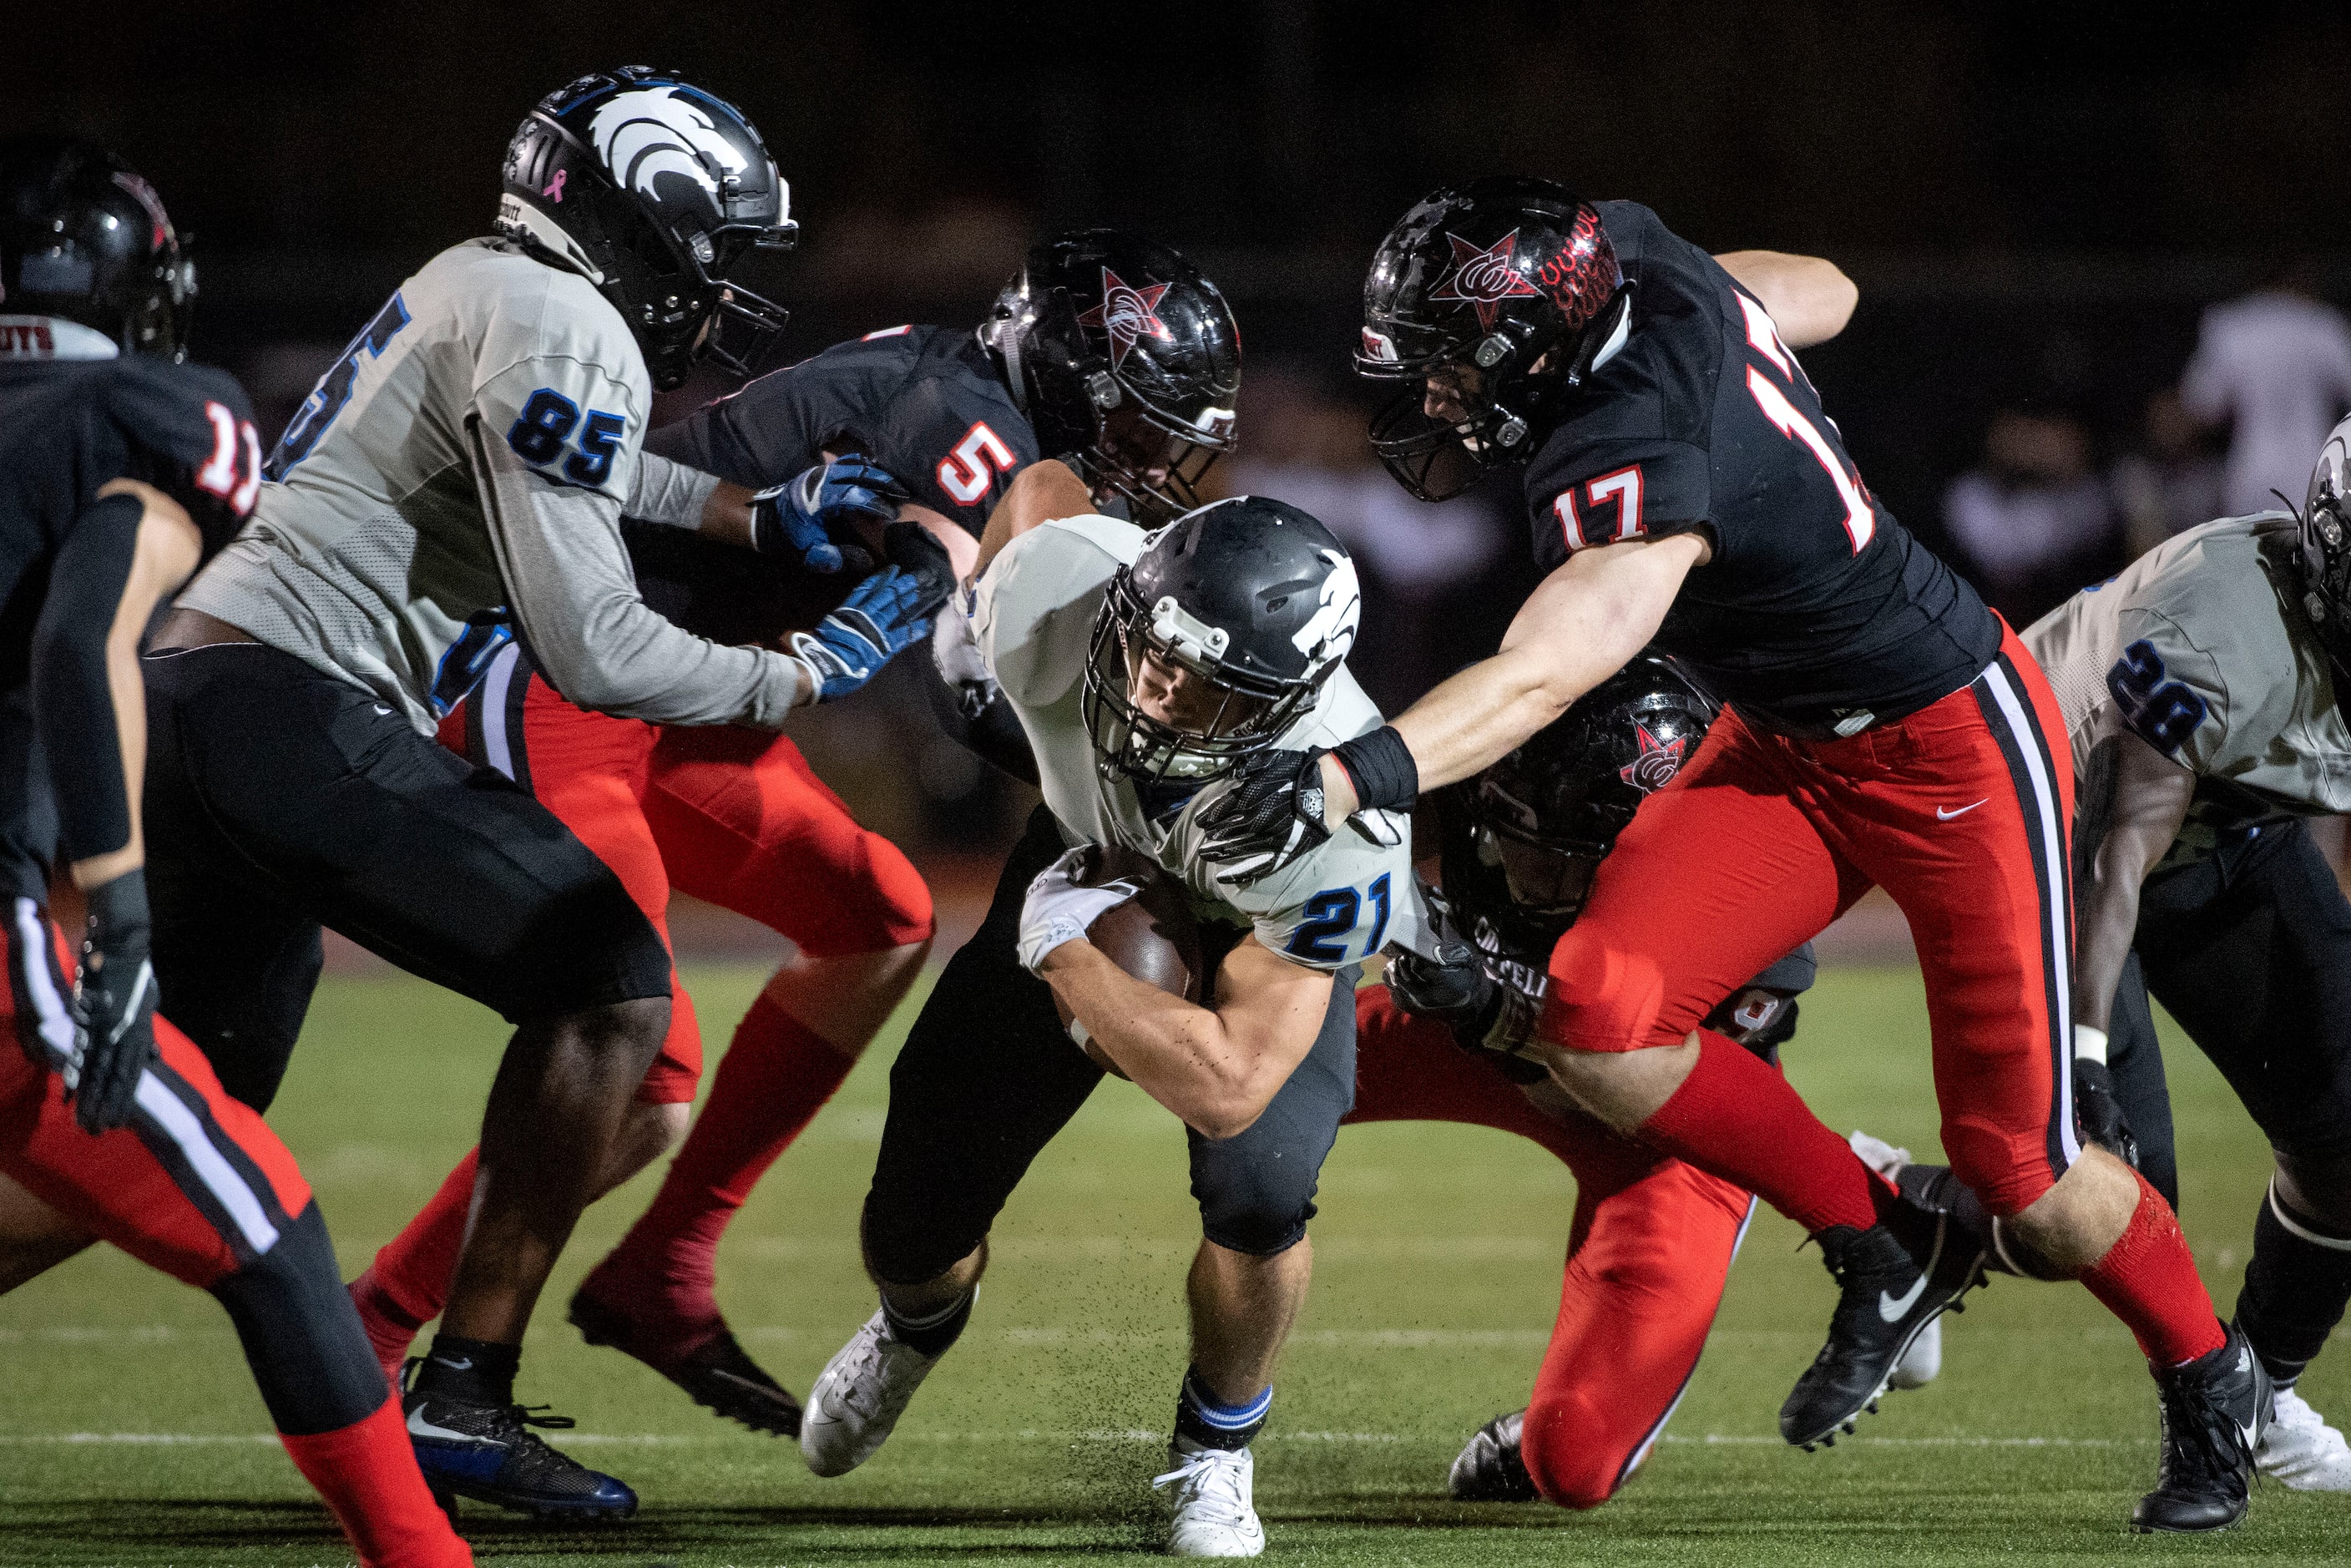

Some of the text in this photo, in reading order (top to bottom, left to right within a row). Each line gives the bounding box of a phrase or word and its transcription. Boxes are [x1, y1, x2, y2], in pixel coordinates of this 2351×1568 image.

[507, 387, 625, 487] 85
[936, 420, 1017, 507] 5
[1553, 463, 1649, 553] 17
[1284, 871, 1391, 962] 21
